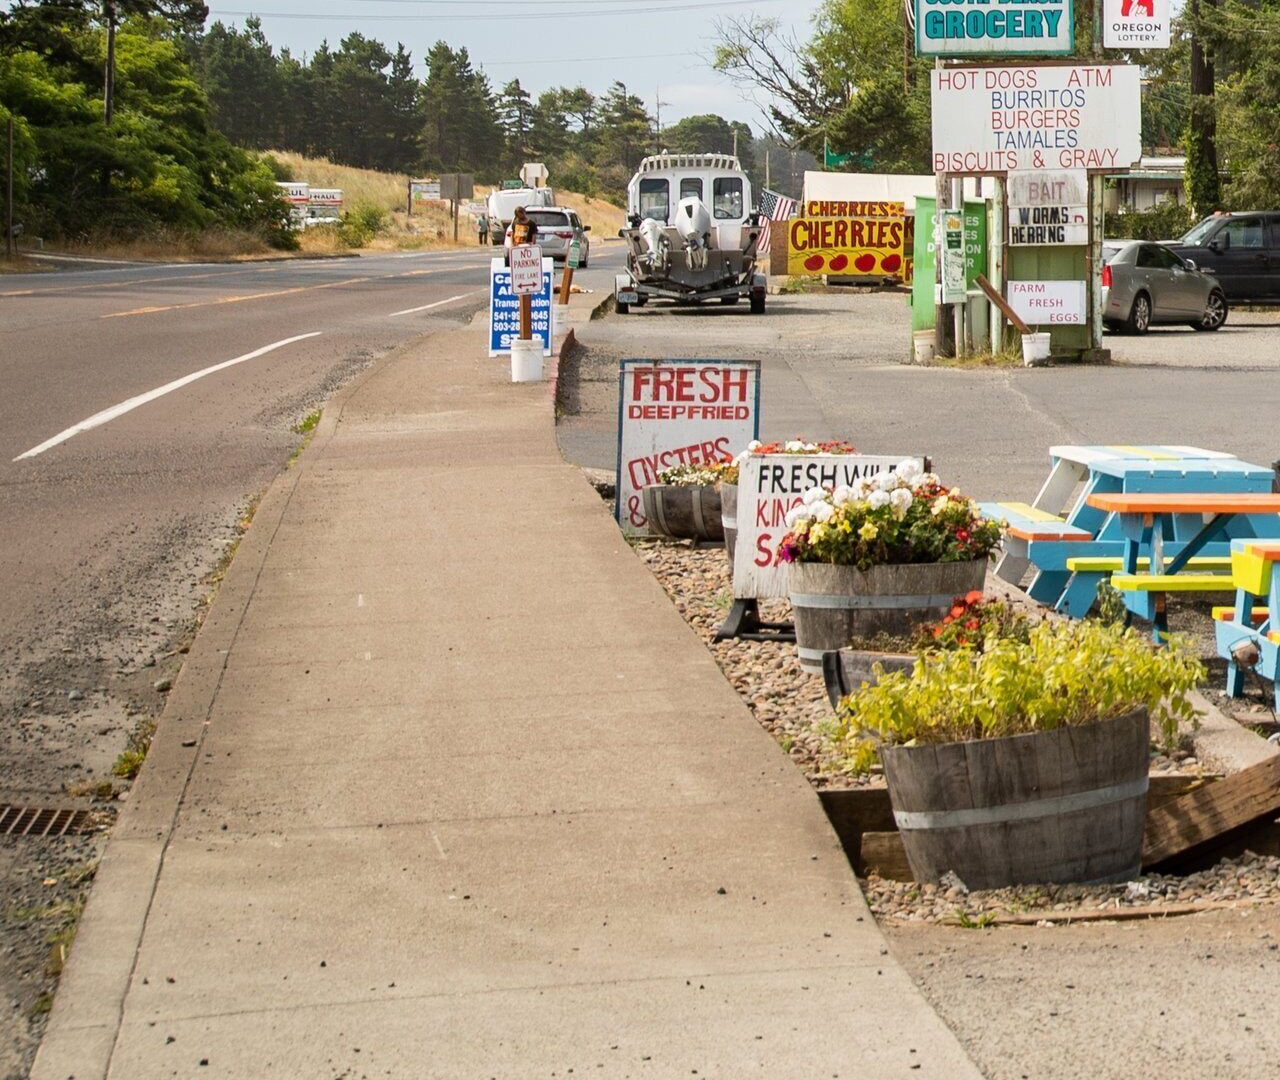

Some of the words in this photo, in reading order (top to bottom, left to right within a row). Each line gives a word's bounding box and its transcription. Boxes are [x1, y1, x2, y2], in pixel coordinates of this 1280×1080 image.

[924, 10, 1063, 40] GROCERY
[1112, 23, 1161, 32] OREGON
[938, 72, 978, 90] HOT
[985, 70, 1037, 89] DOGS
[1068, 69, 1112, 87] ATM
[992, 90, 1086, 109] BURRITOS
[992, 110, 1080, 129] BURGERS
[993, 130, 1078, 149] TAMALES
[934, 151, 1018, 171] BISCUITS
[1033, 151, 1045, 168] &
[1059, 149, 1119, 167] GRAVY
[1028, 182, 1065, 201] BAIT
[808, 201, 889, 216] CHERRIES
[1019, 207, 1069, 225] WORMS
[791, 220, 903, 251] CHERRIES
[1013, 284, 1045, 293] FARM
[1029, 298, 1063, 307] FRESH
[1050, 313, 1079, 322] EGGS
[633, 367, 748, 403] FRESH
[758, 463, 838, 493] FRESH
[628, 495, 647, 528] &
